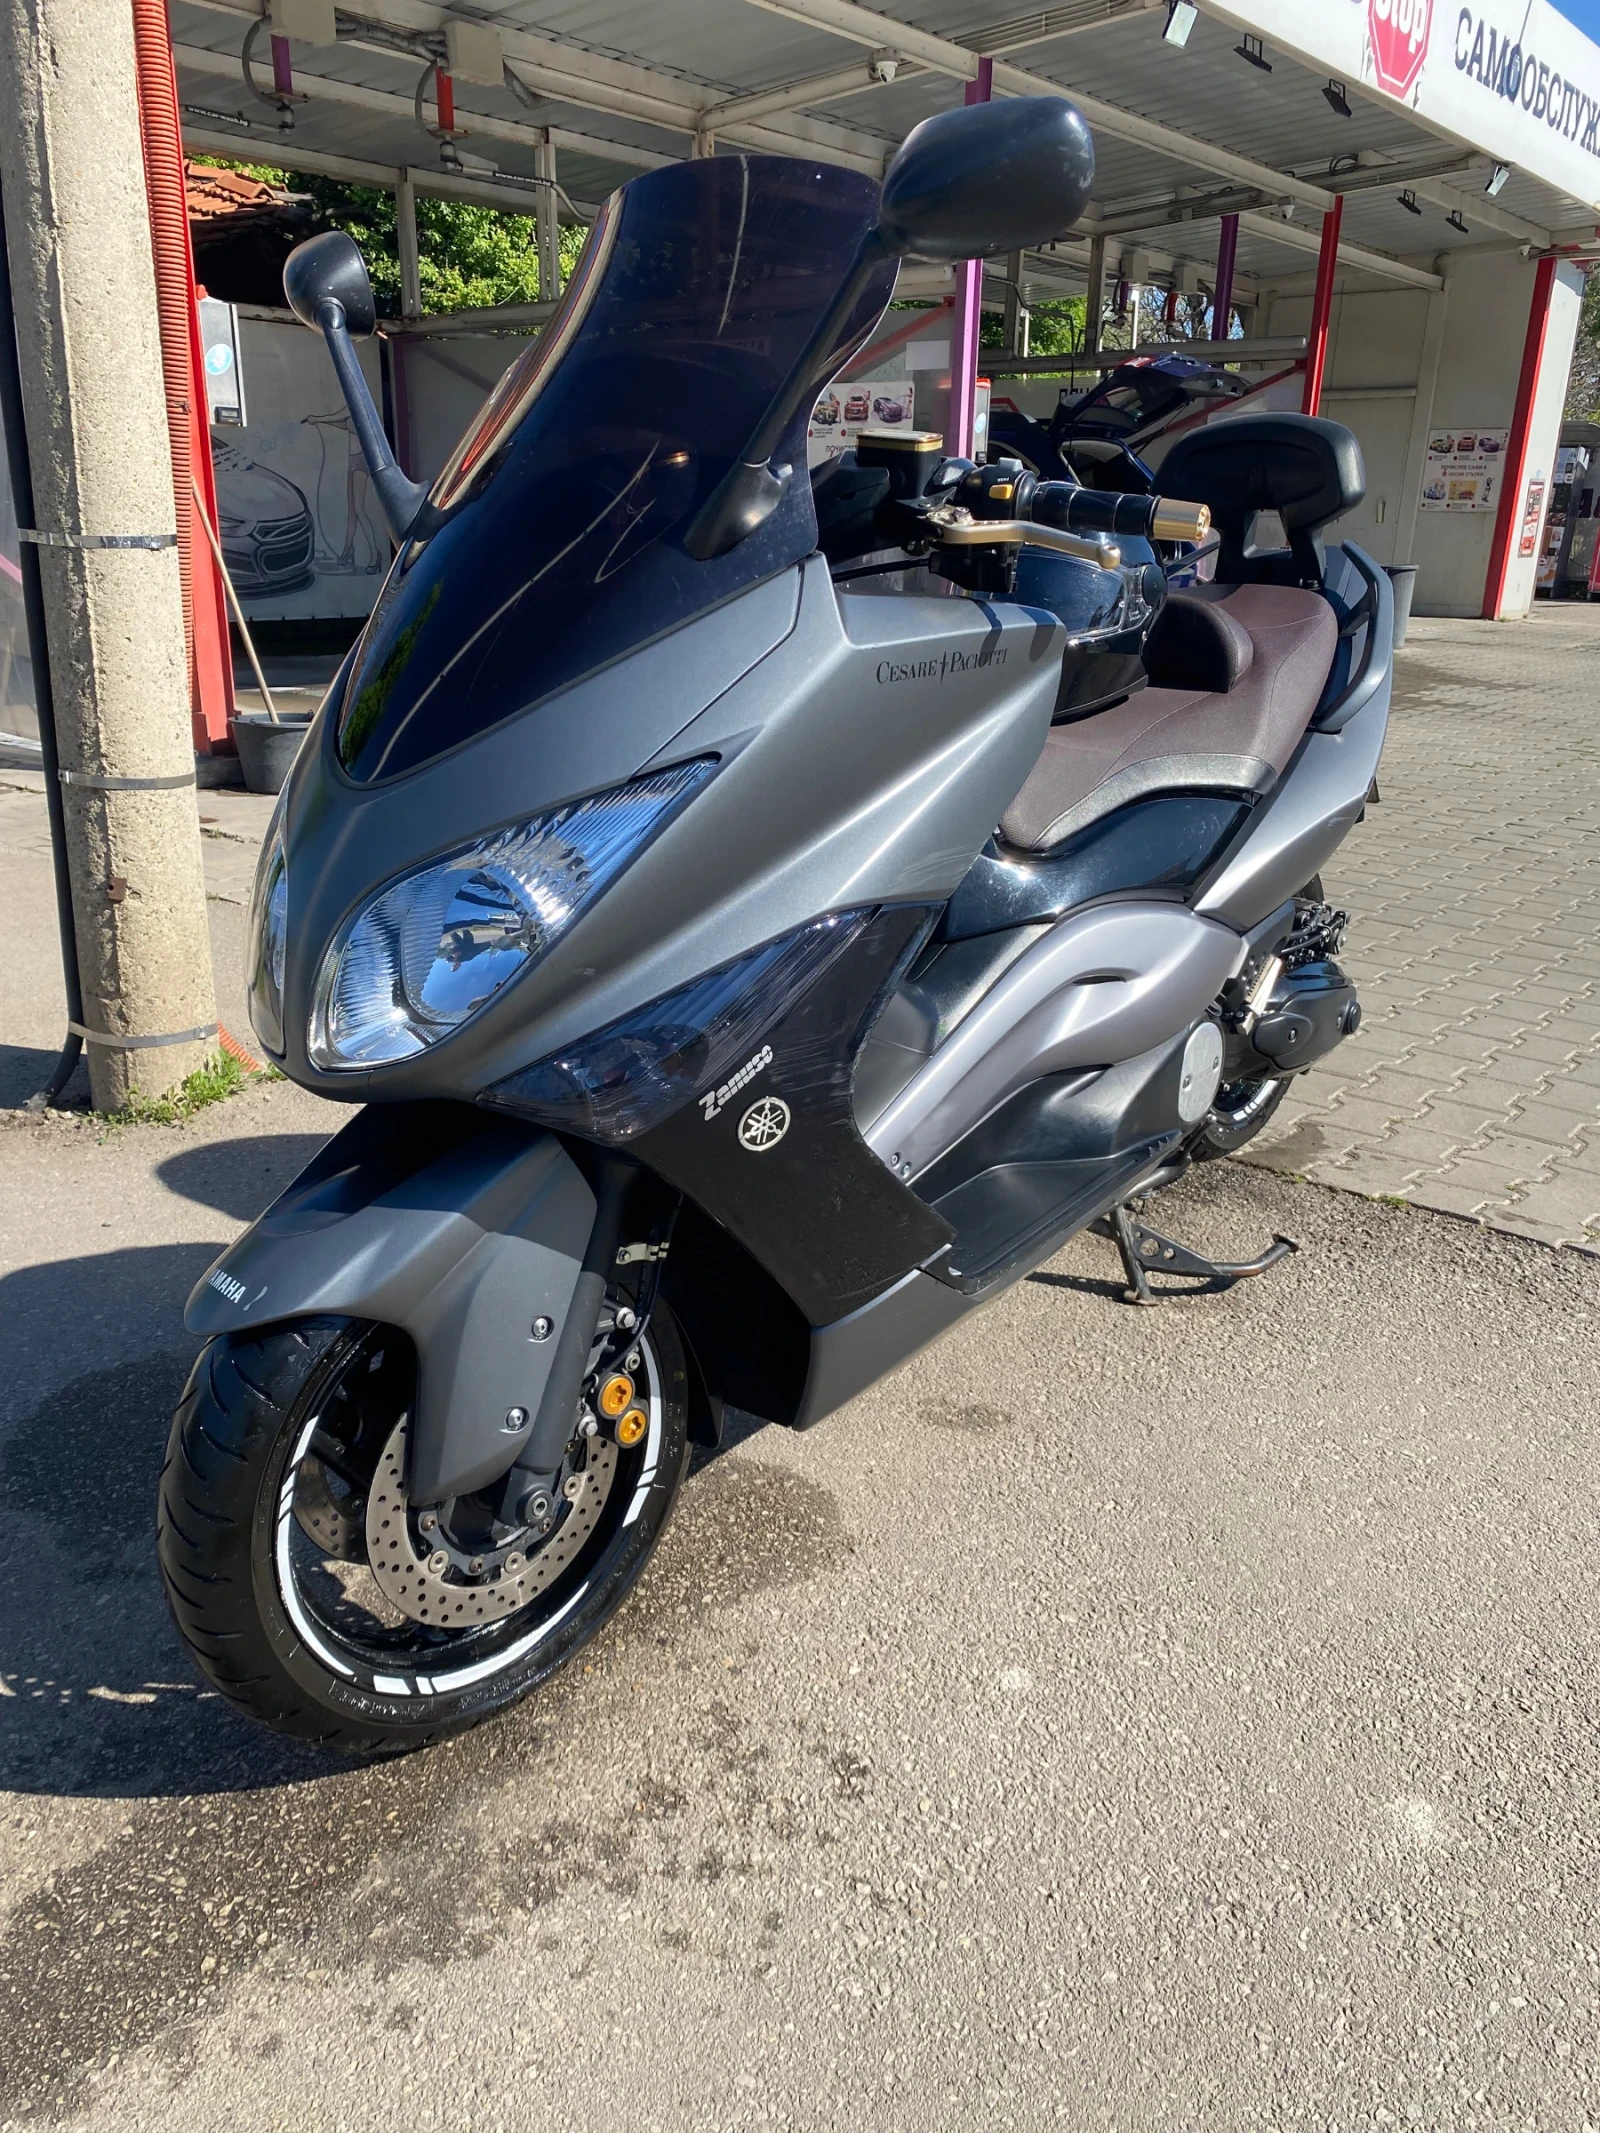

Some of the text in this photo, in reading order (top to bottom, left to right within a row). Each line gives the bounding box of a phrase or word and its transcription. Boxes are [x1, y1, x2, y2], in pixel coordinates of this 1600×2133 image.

[1454, 7, 1600, 158] САМООБСЛУЖ
[187, 106, 249, 127] www.car-wash.bg
[876, 649, 1008, 684] CESARE PACIOTTI
[699, 1045, 774, 1121] Zanuso
[206, 1268, 247, 1304] AMAHA
